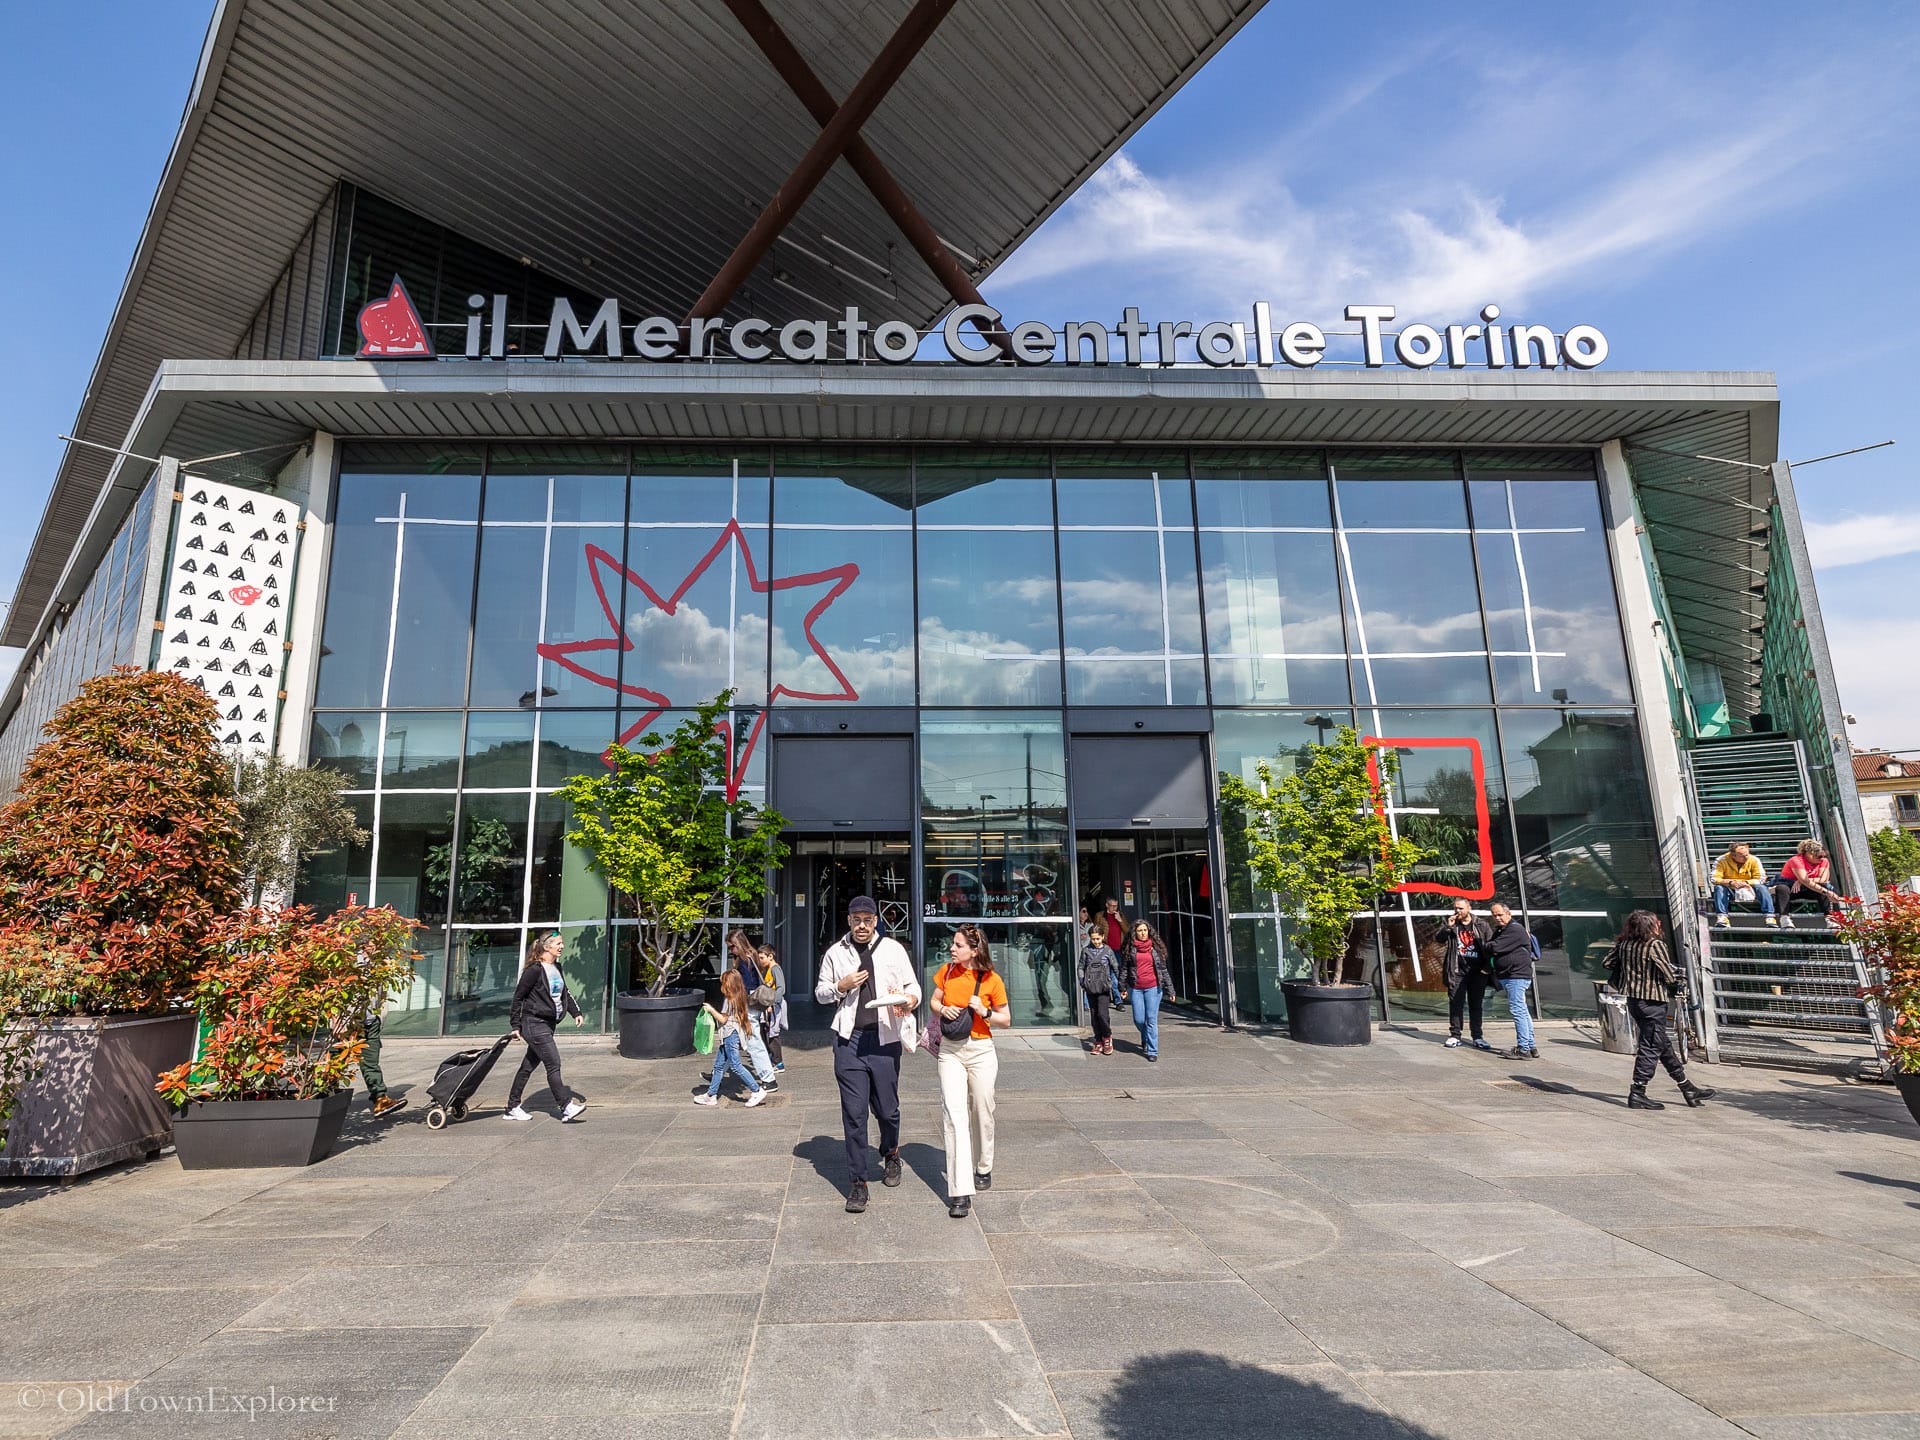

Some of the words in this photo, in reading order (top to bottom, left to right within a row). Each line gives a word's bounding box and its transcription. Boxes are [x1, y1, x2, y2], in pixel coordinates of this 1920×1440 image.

[468, 294, 508, 361] il
[543, 297, 919, 365] Mercato
[944, 301, 1327, 368] Centrale
[1344, 304, 1609, 369] Torino
[924, 903, 937, 916] 25
